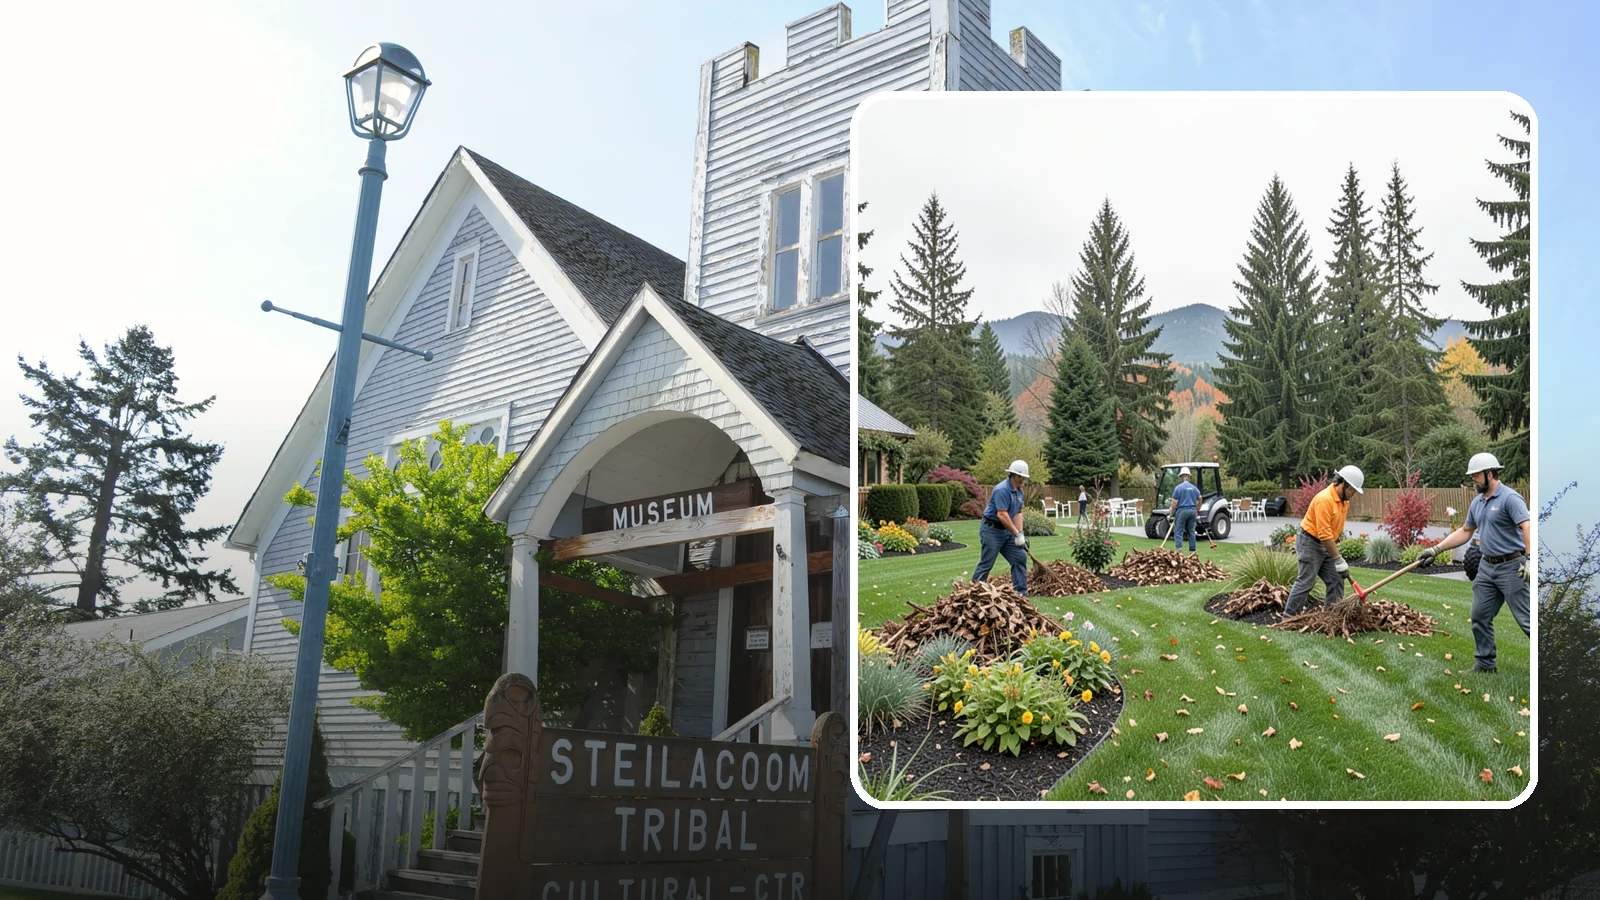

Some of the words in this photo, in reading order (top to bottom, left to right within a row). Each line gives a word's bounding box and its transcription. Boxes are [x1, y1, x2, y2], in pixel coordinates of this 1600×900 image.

[612, 491, 713, 530] MUSEUM
[551, 738, 809, 793] STEILACOOM
[615, 806, 757, 852] TRIBAL
